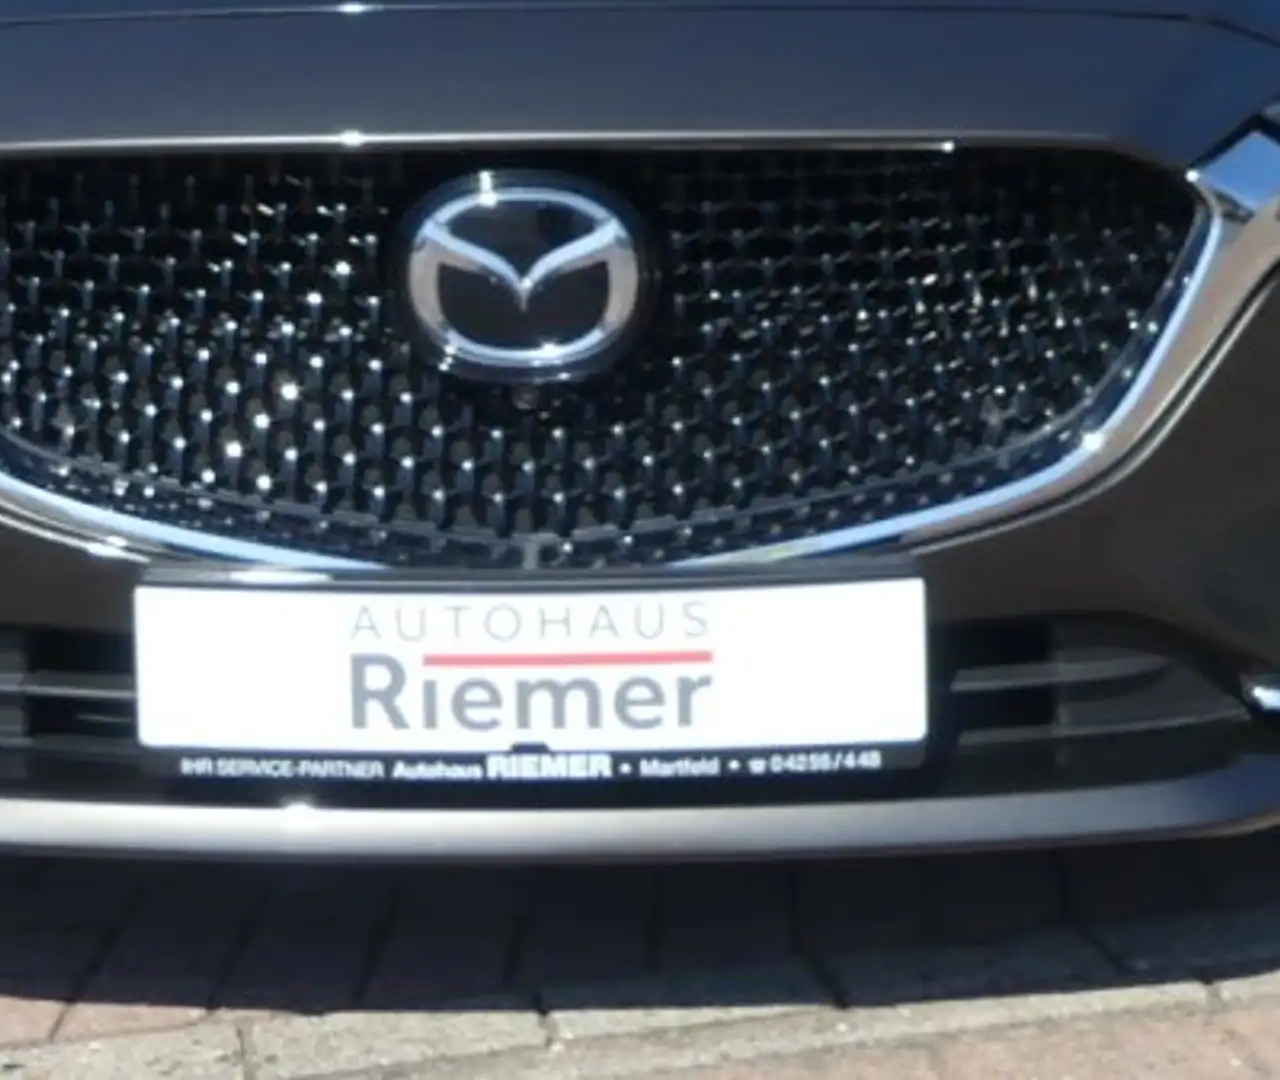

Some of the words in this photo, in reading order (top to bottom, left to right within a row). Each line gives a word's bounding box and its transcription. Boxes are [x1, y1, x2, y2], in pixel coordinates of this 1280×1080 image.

[349, 600, 710, 643] AUTOHAUS
[350, 652, 713, 732] Riemer
[180, 757, 213, 776] IHR
[218, 757, 385, 779] SERVICE-PARTNER
[392, 759, 483, 780] Autohaus
[485, 753, 613, 780] RIEMER
